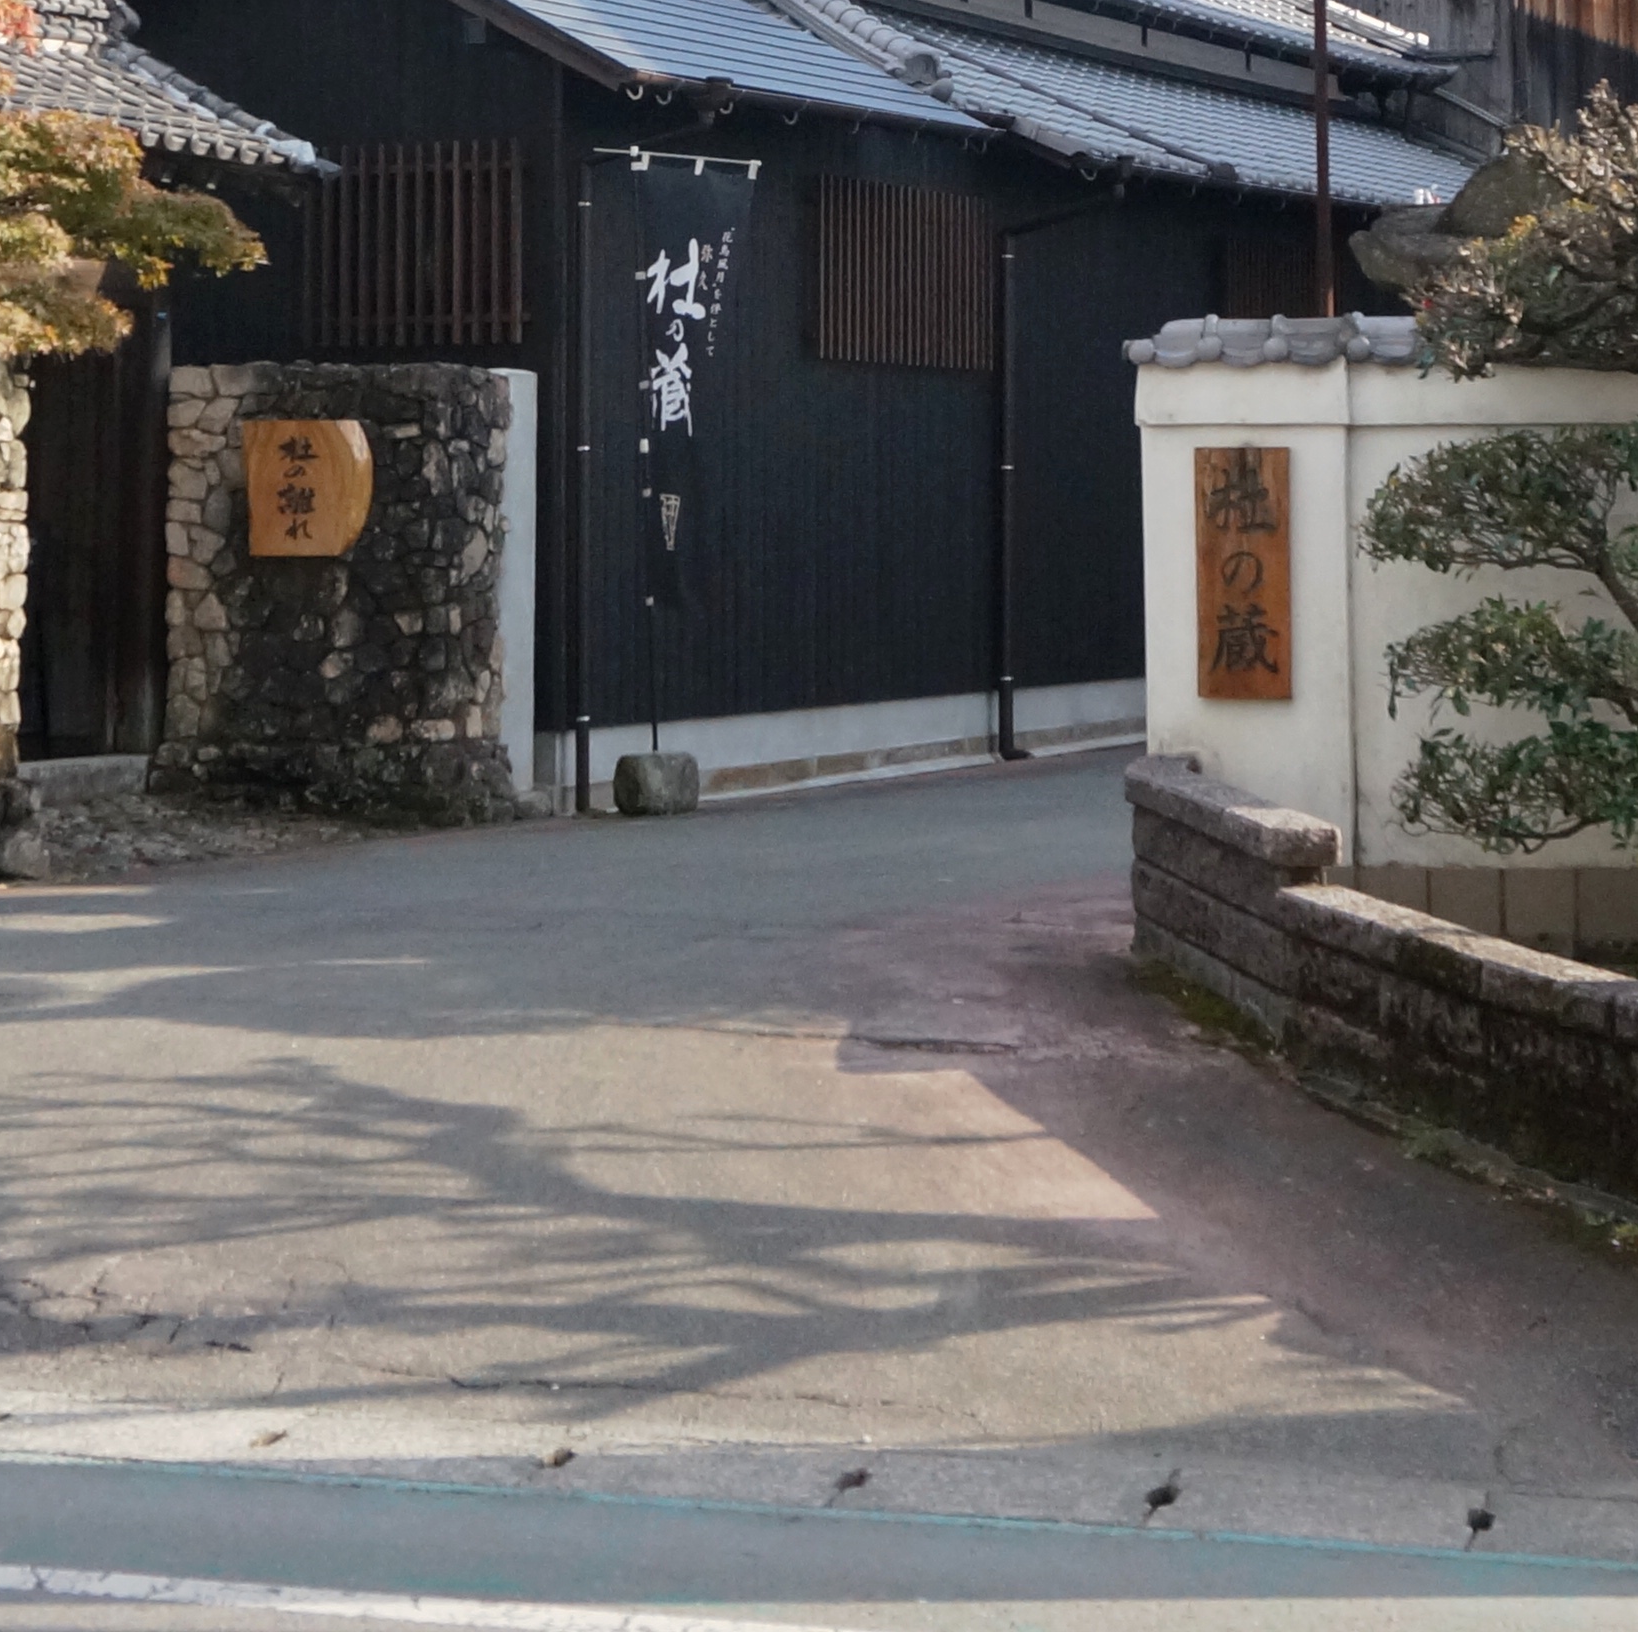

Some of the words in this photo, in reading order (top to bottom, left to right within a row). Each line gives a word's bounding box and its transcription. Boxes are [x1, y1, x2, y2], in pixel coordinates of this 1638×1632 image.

[277, 435, 320, 541] 杜の離れ
[1207, 466, 1279, 675] 杜の蔵
